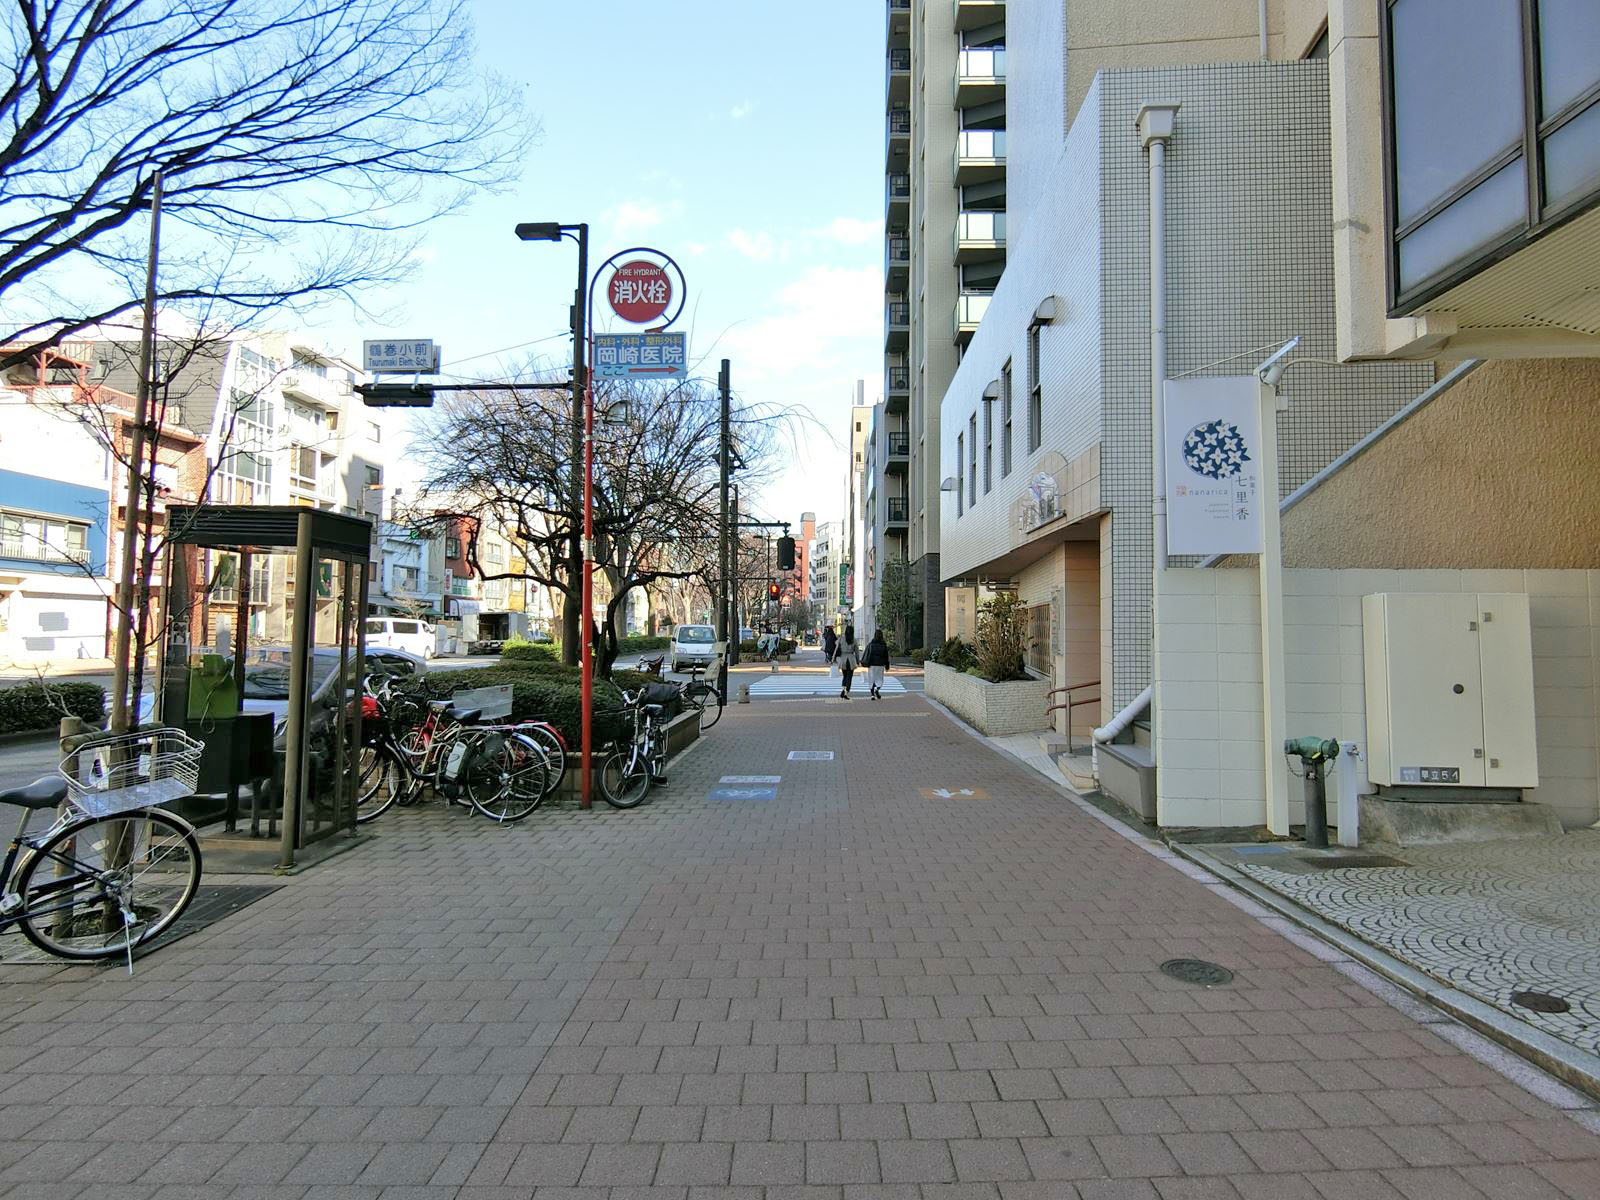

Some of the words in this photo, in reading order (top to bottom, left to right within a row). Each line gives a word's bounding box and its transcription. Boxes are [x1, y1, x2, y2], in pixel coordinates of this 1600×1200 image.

[614, 280, 667, 303] 消火栓
[598, 346, 682, 364] 岡崎医院
[602, 366, 625, 376] ここ
[1235, 476, 1249, 520] 七里香
